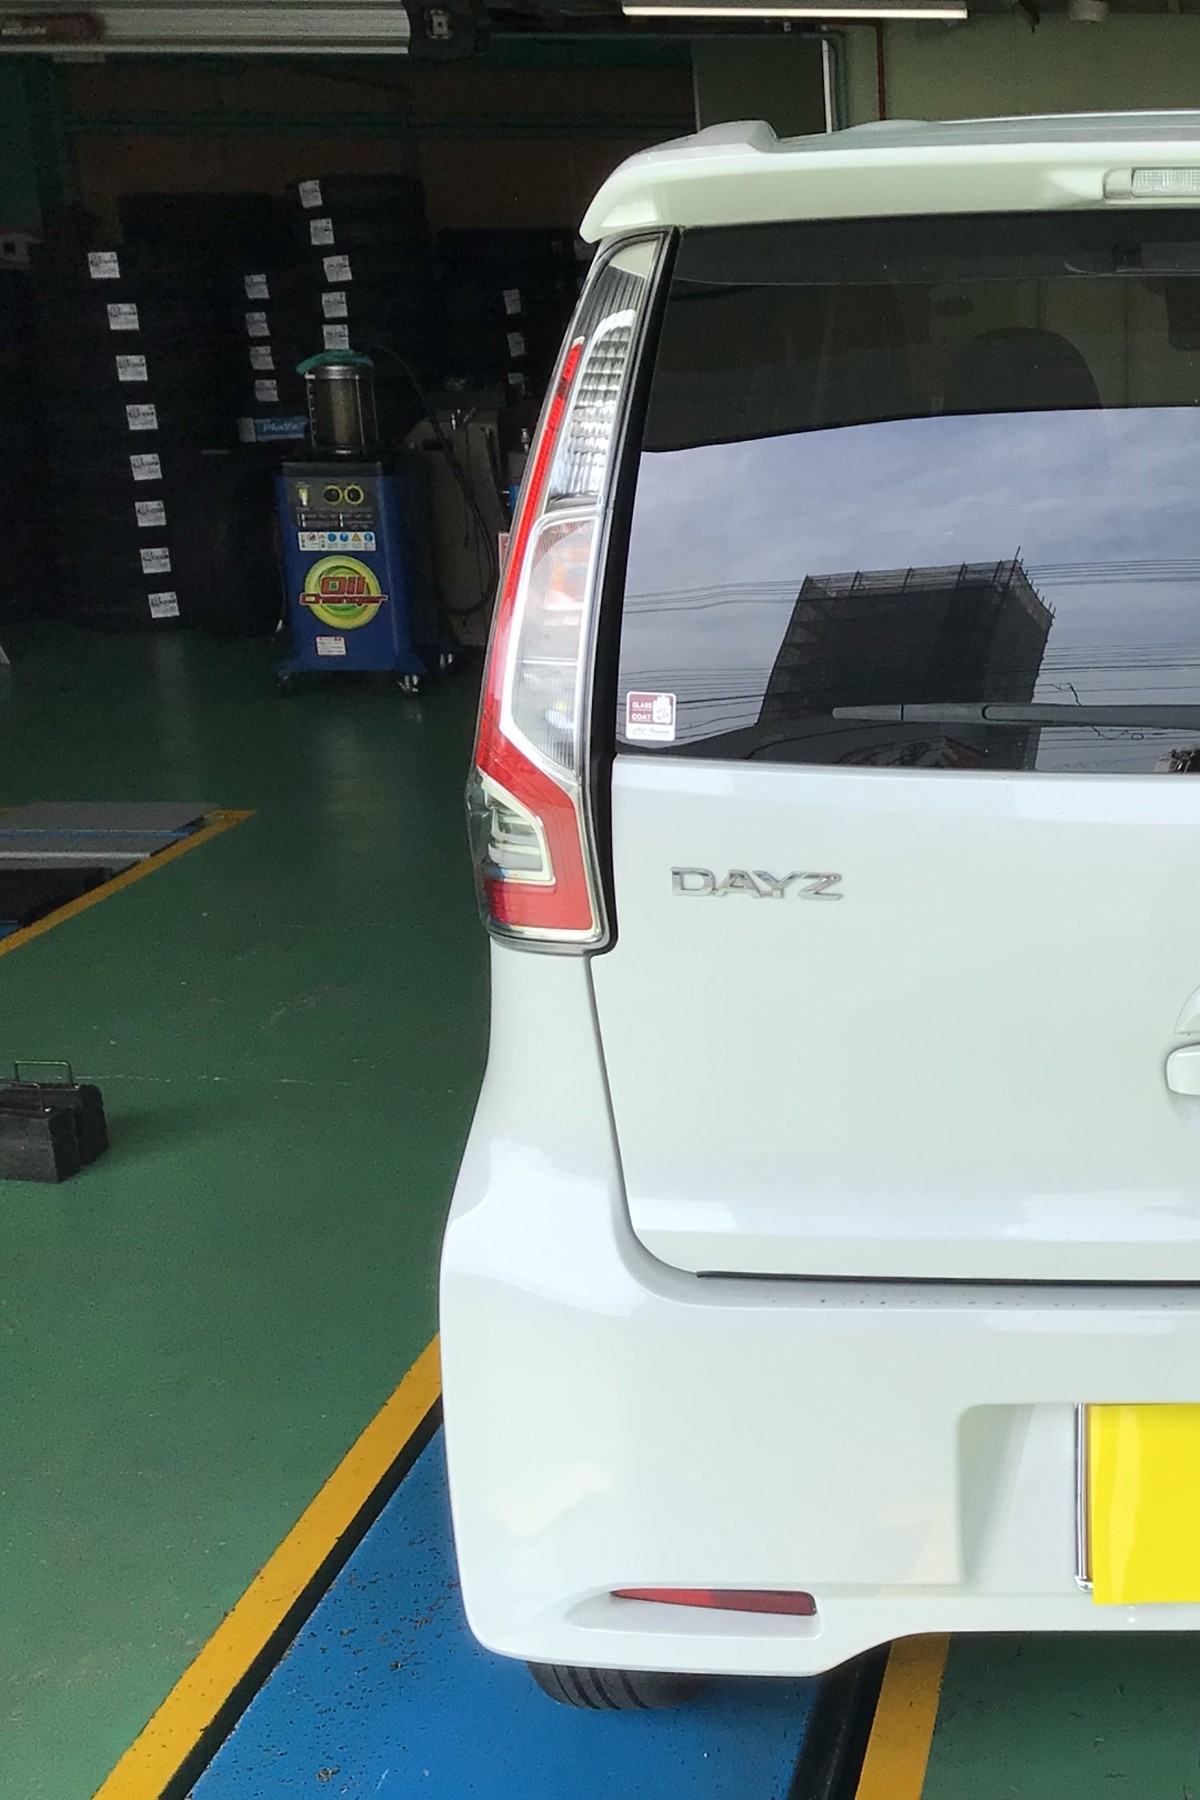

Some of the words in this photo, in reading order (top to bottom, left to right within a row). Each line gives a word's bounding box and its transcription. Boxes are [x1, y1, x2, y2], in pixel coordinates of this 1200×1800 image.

[321, 576, 366, 595] Oil
[631, 701, 653, 709] GLASS
[631, 713, 652, 721] COAT
[670, 866, 844, 901] DAYZ
